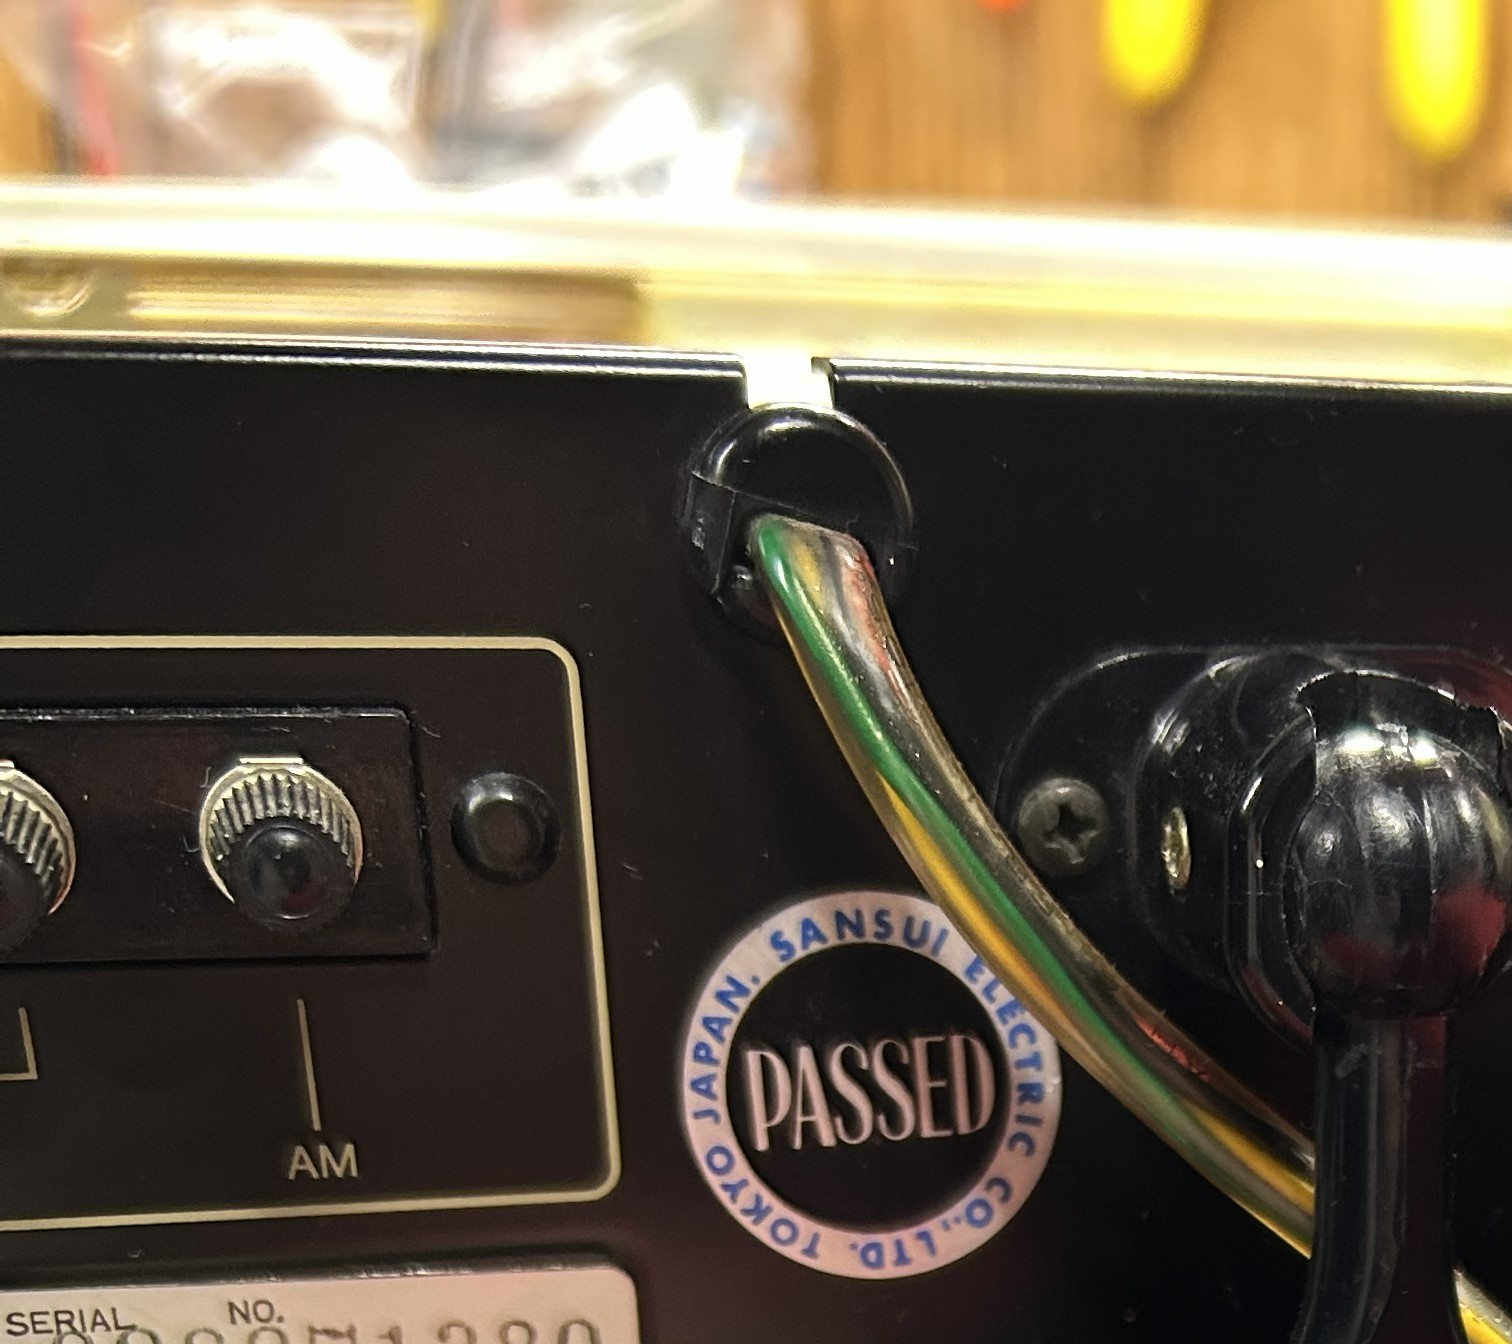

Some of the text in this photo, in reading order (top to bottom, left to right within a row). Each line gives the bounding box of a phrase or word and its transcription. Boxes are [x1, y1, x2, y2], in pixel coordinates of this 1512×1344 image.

[705, 908, 1045, 1260] SANSUI ELECTRIC TOKYO
[745, 1034, 997, 1152] PASSED
[288, 1143, 359, 1181] AM
[5, 1299, 286, 1336] SERIAL NO.
